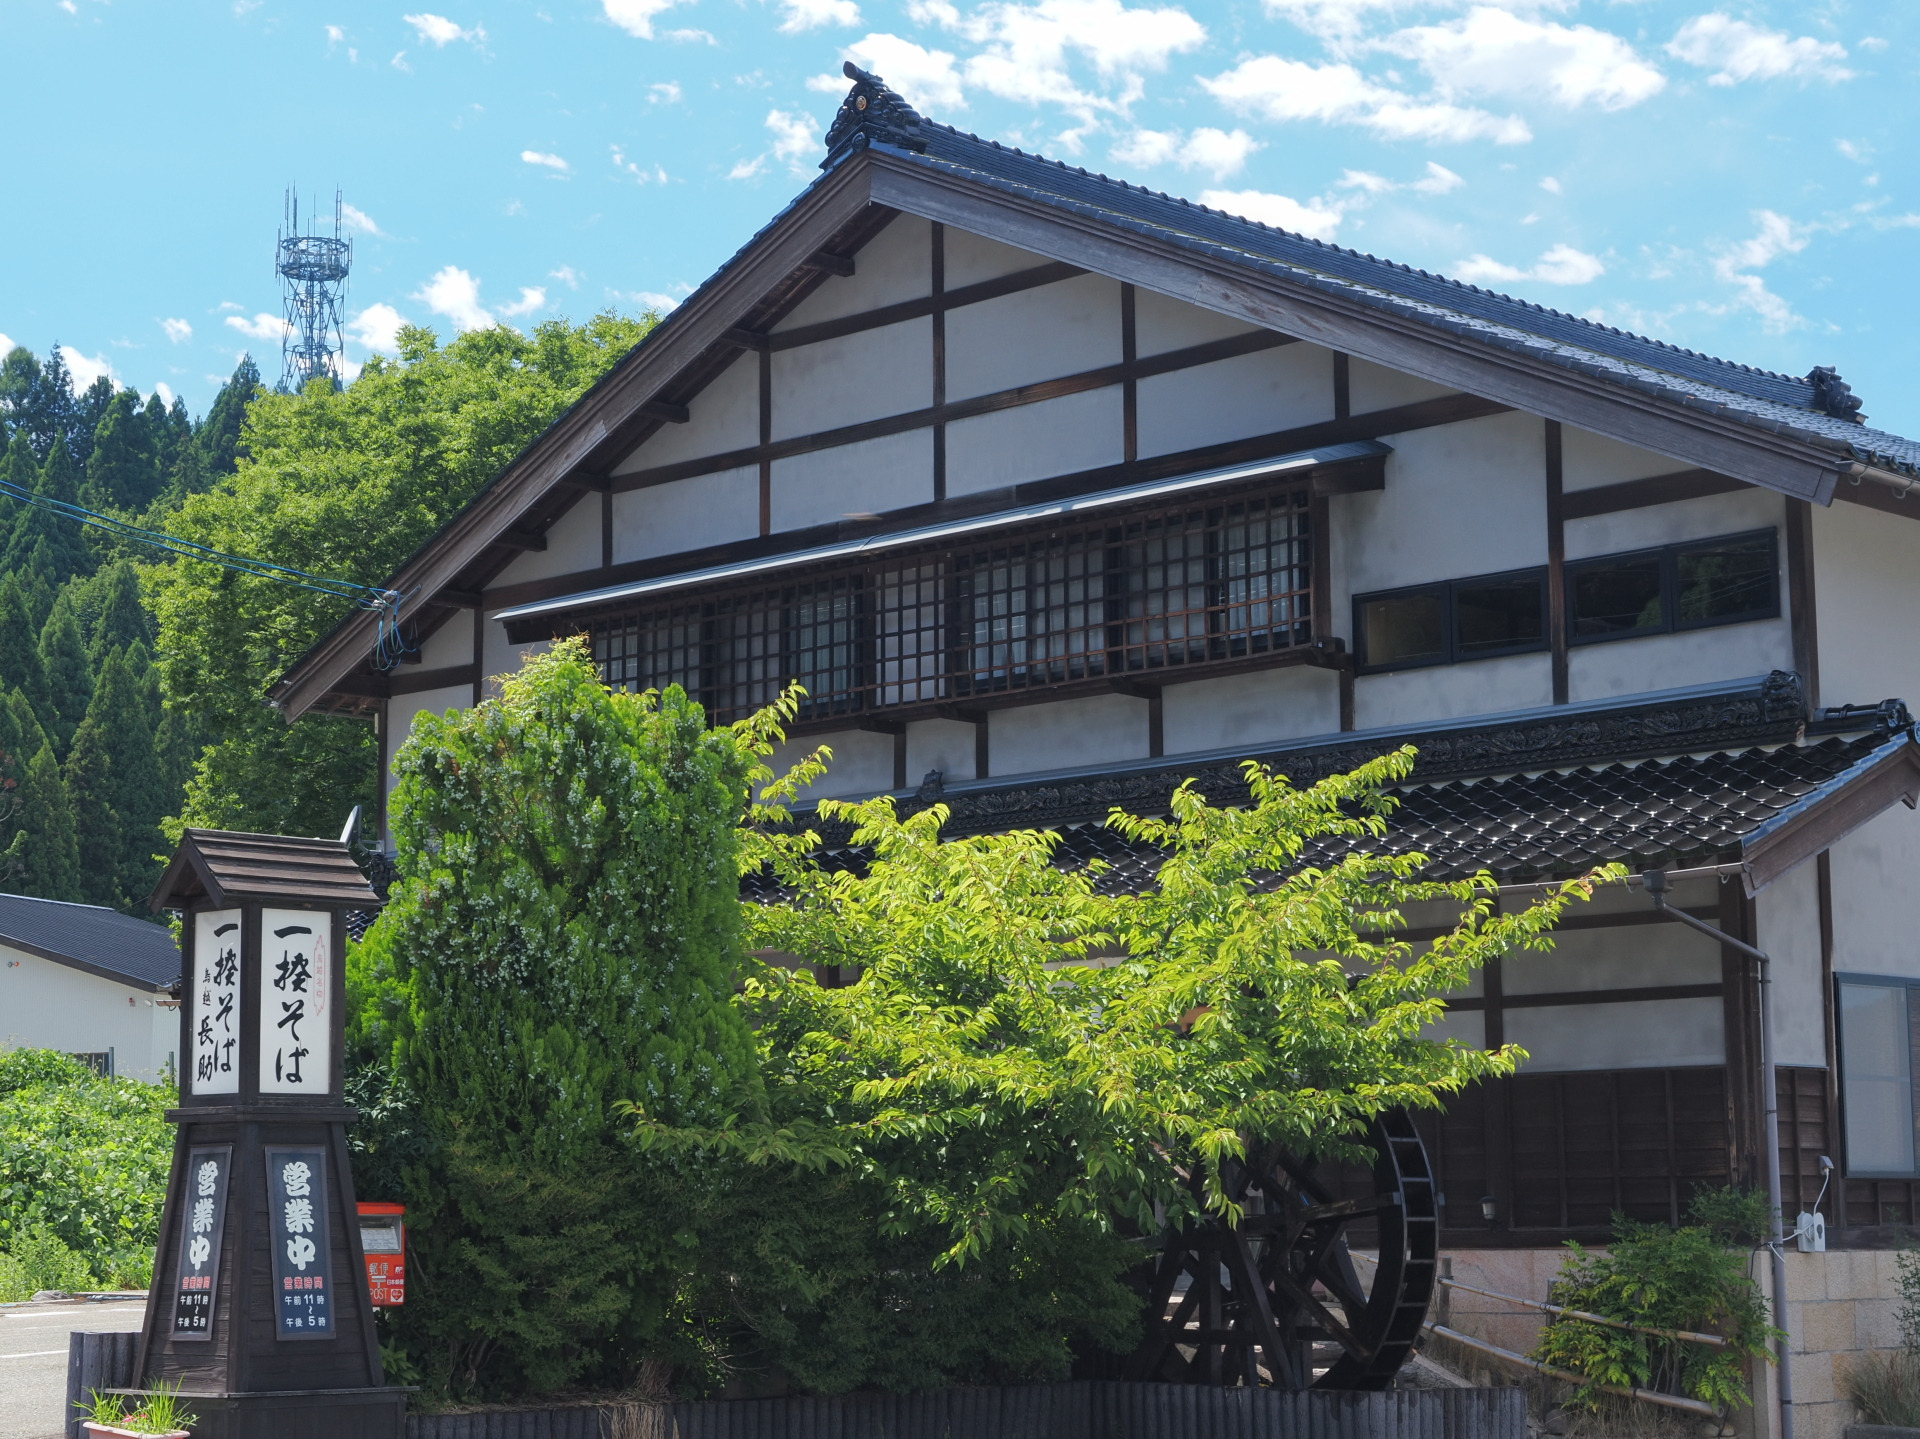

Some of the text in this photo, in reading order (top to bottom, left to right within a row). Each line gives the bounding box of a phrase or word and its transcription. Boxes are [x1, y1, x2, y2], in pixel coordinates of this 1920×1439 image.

[213, 923, 239, 1073] 一揆そば
[273, 925, 313, 1083] 一揆そば
[189, 1160, 218, 1271] 営業中
[282, 1161, 316, 1271] 営業中
[369, 1262, 389, 1275] 郵便
[182, 1276, 211, 1290] 営業時間
[283, 1276, 324, 1290] 営業時間
